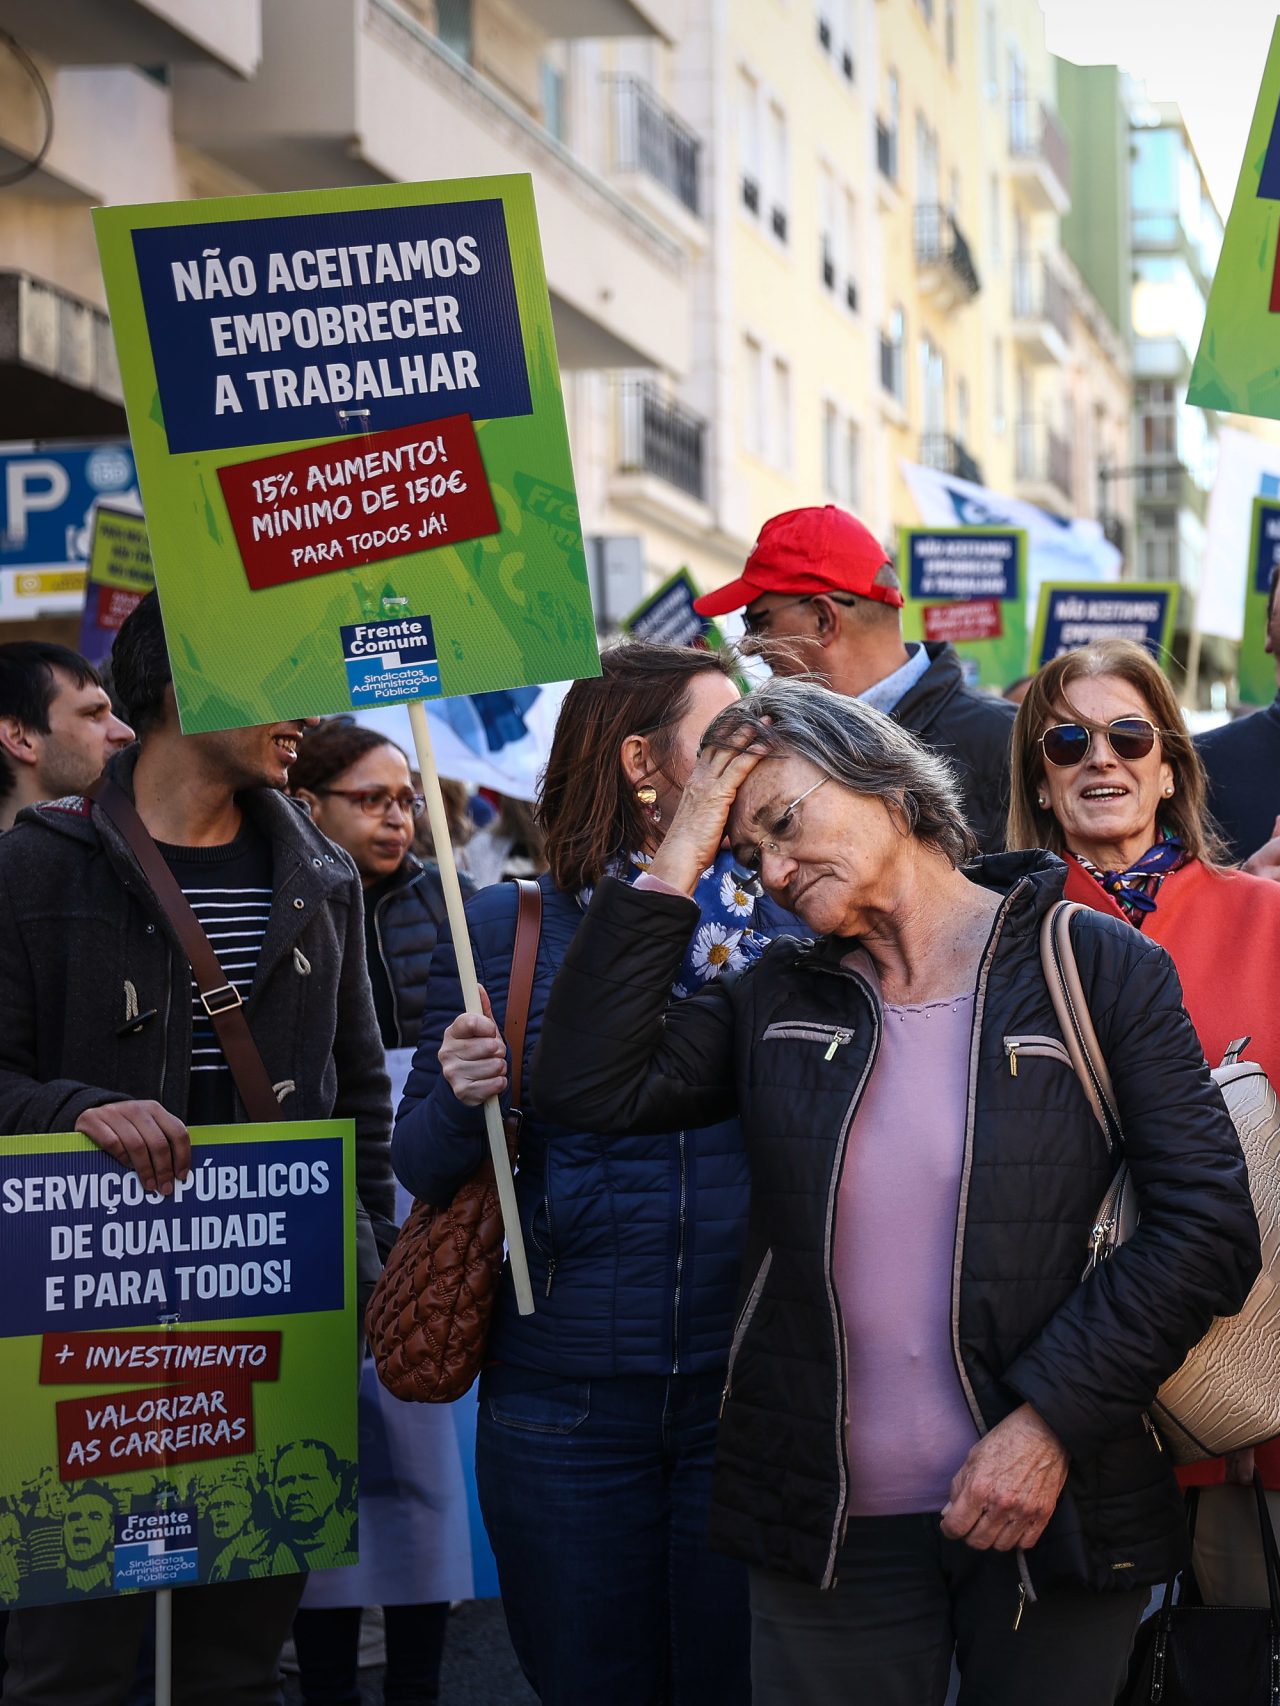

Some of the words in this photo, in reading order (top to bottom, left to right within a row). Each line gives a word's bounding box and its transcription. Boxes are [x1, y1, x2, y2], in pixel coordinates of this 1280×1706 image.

[172, 248, 256, 301] NÃO
[269, 236, 480, 293] ACEITAMOS
[211, 296, 462, 356] EMPOBRECER
[216, 375, 242, 414] A
[247, 351, 480, 410] TRABALHAR
[252, 472, 297, 503] 15%
[307, 436, 447, 492] AUMENTO!
[6, 459, 70, 542] P
[252, 496, 352, 541] MÍNIMO
[362, 485, 398, 514] DE
[405, 470, 467, 504] 150€
[292, 540, 343, 567] PARA
[347, 524, 411, 553] TODOS
[419, 511, 446, 537] JÁ!
[350, 635, 428, 655] Comum
[355, 621, 422, 640] Frente
[352, 675, 438, 693] Administração
[364, 669, 424, 683] Sindicatos
[375, 686, 419, 698] Pública
[175, 1159, 329, 1202] PÚBLICOS
[51, 1224, 92, 1260] DE
[102, 1212, 286, 1259] QUALIDADE
[46, 1276, 64, 1311] E
[75, 1269, 167, 1308] PARA
[175, 1260, 290, 1300] TODOS!
[56, 1345, 74, 1363] +
[86, 1345, 266, 1369] INVESTIMENTO
[86, 1391, 227, 1429] VALORIZAR
[67, 1440, 100, 1465] AS
[110, 1418, 245, 1456] CARREIRAS
[121, 1524, 191, 1541] Comum
[128, 1511, 189, 1528] Frente
[117, 1562, 195, 1577] Administração
[129, 1556, 184, 1569] Sindicatos
[137, 1571, 177, 1583] Pública
